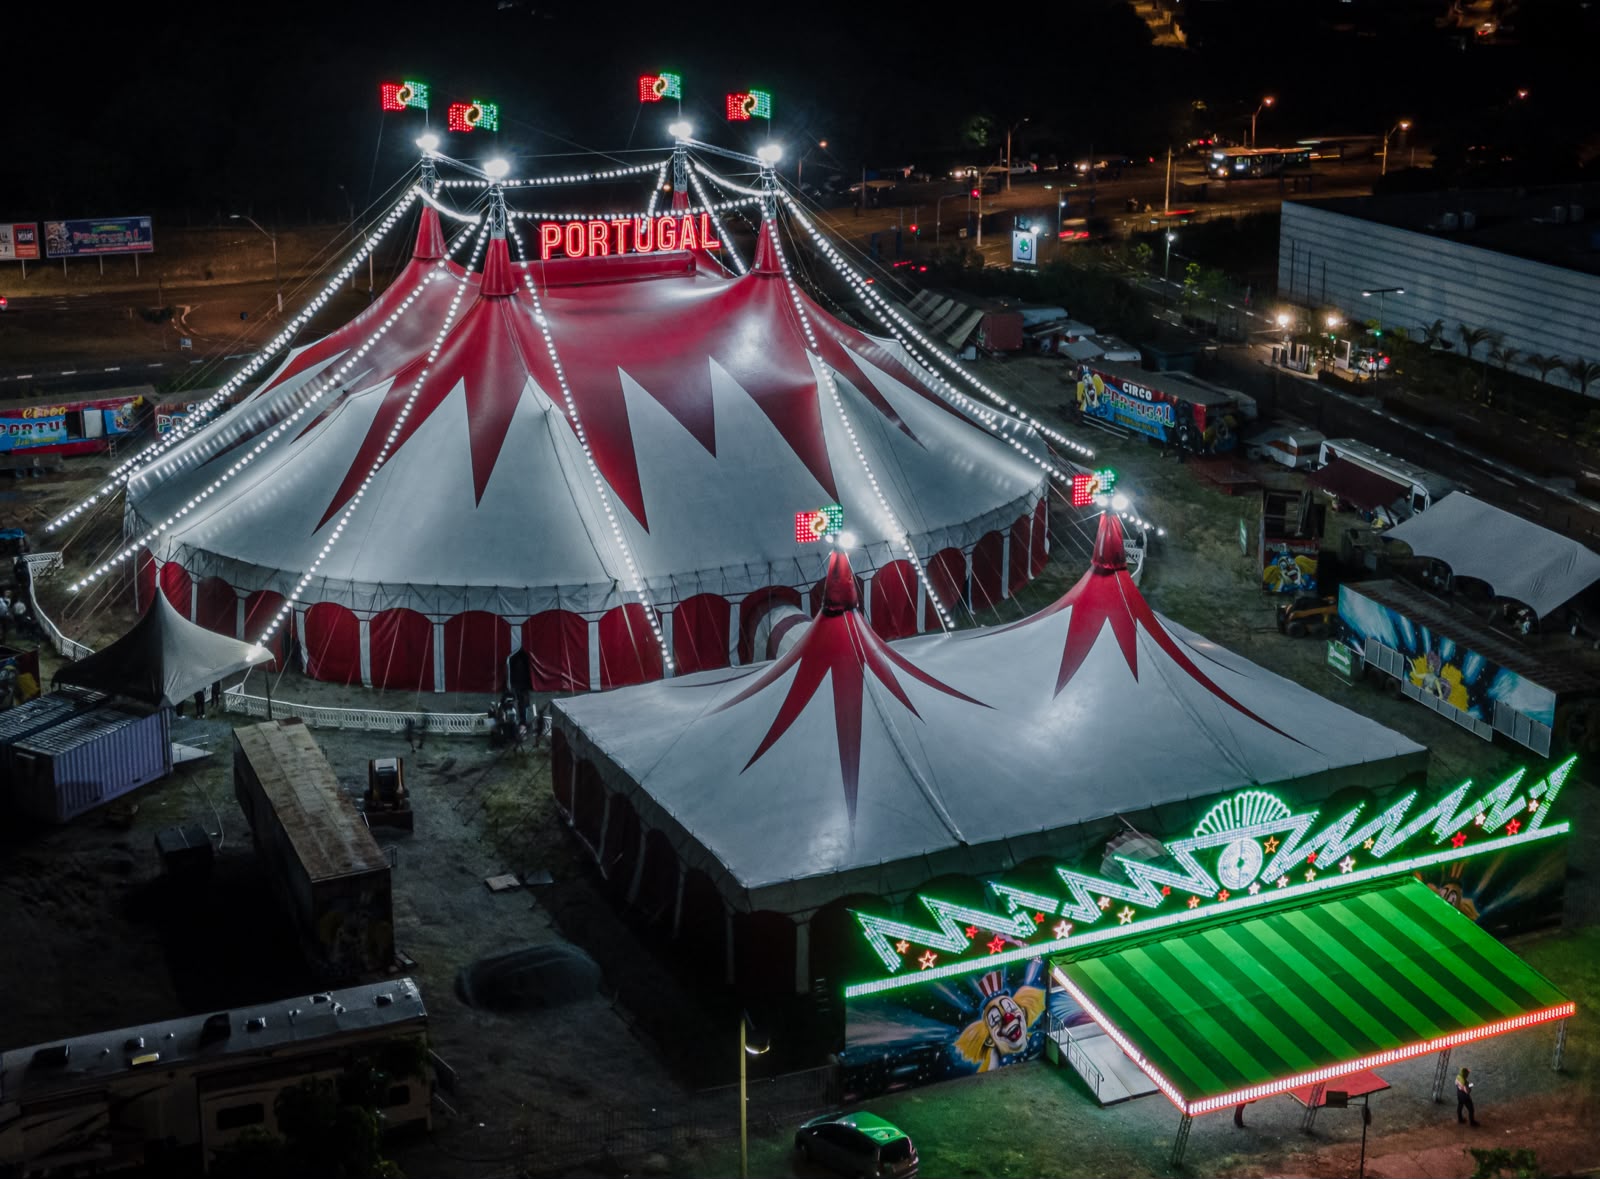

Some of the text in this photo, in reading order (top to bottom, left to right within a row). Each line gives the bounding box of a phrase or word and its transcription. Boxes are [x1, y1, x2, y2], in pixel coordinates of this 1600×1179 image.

[541, 213, 721, 259] PORTUGAL
[1102, 386, 1175, 427] PORTUGAL
[1123, 383, 1152, 401] CIRCO
